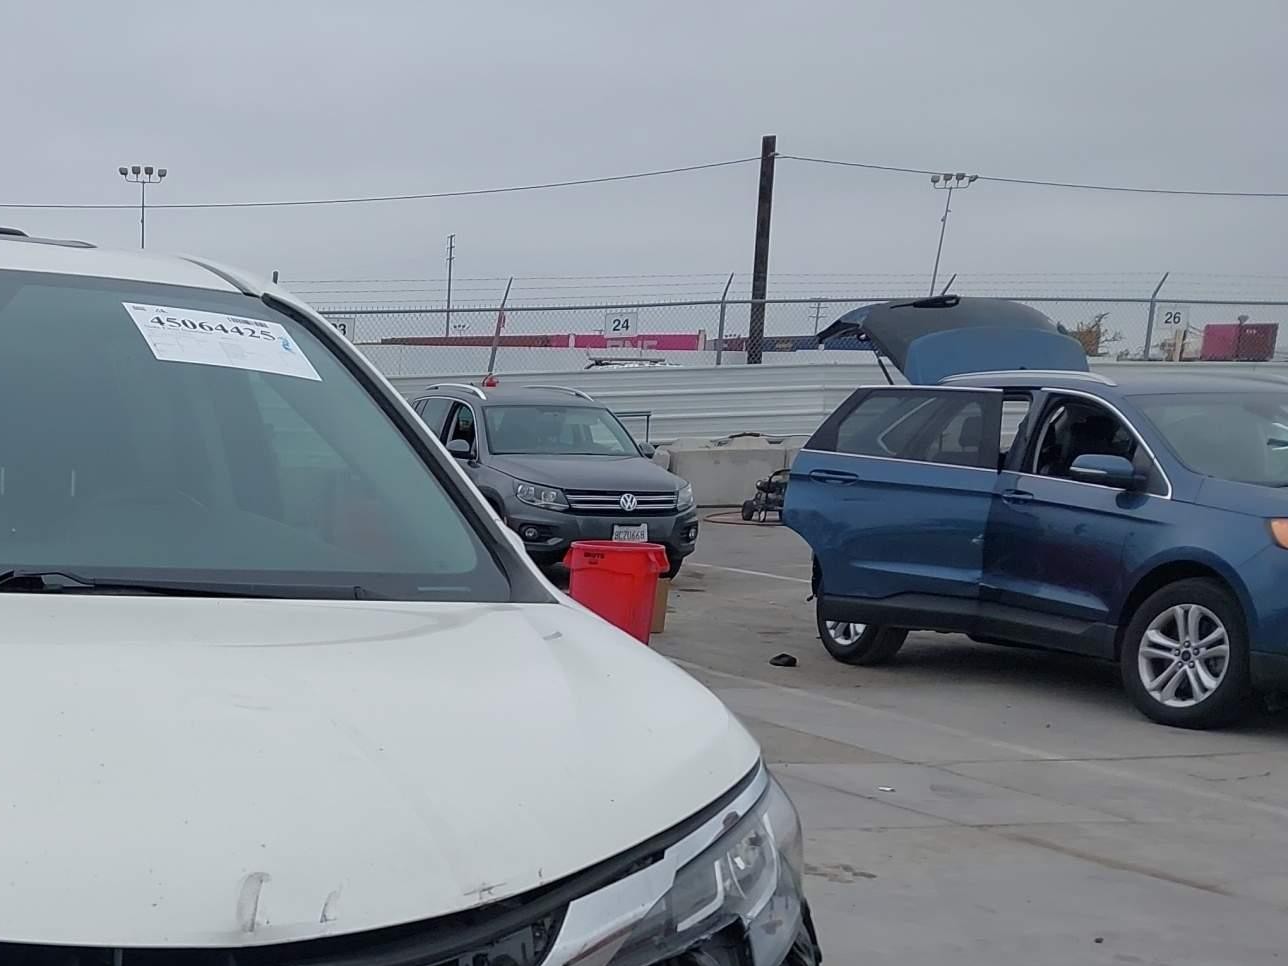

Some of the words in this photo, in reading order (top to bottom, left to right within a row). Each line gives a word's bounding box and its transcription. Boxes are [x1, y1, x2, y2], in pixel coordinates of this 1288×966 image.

[612, 318, 630, 332] 24
[1164, 312, 1181, 325] 26
[150, 315, 276, 342] 45064425
